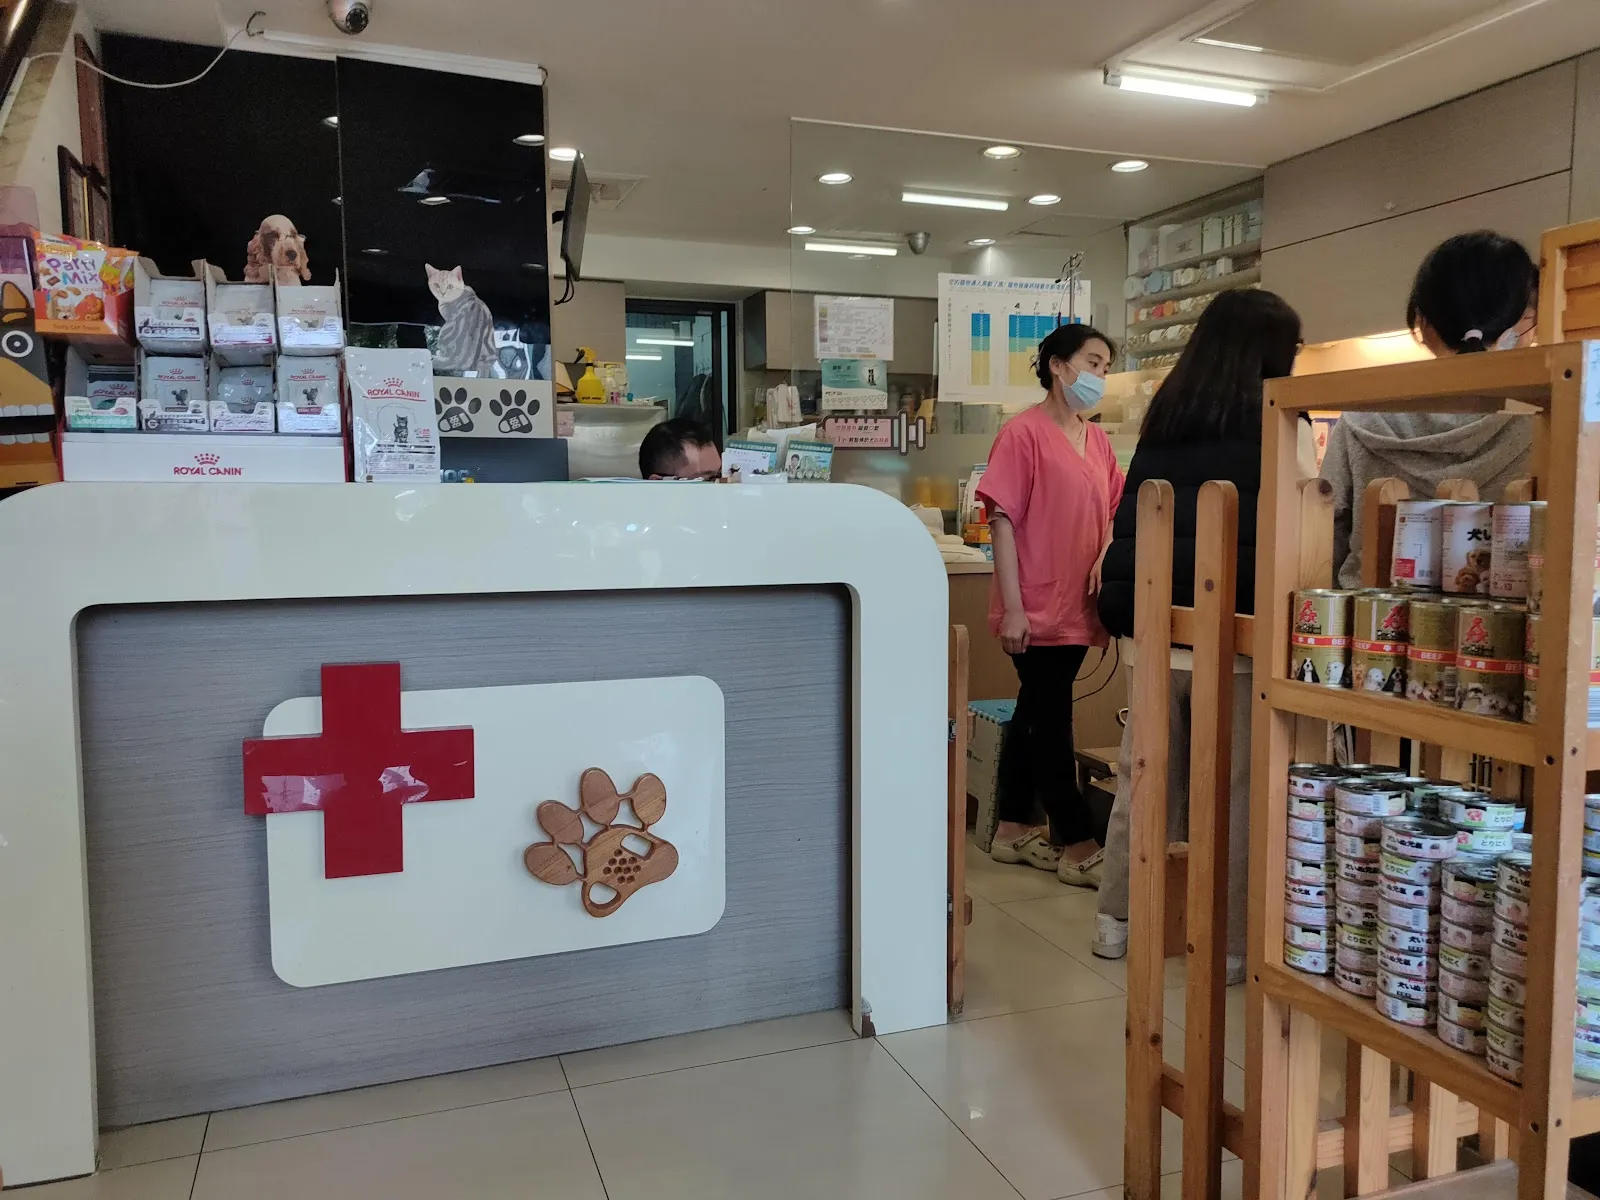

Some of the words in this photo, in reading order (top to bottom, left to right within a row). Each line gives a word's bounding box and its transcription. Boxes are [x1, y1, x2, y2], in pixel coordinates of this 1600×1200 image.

[46, 257, 96, 273] Party
[62, 270, 98, 285] Mix
[367, 389, 392, 397] ROYAL
[394, 389, 421, 398] CANIN
[173, 466, 206, 476] ROYAL
[208, 466, 242, 476] CANIN
[1420, 652, 1444, 660] BEEF
[1481, 839, 1506, 847] とりにく
[1386, 864, 1409, 875] とりにく
[1347, 935, 1373, 945] とりにく
